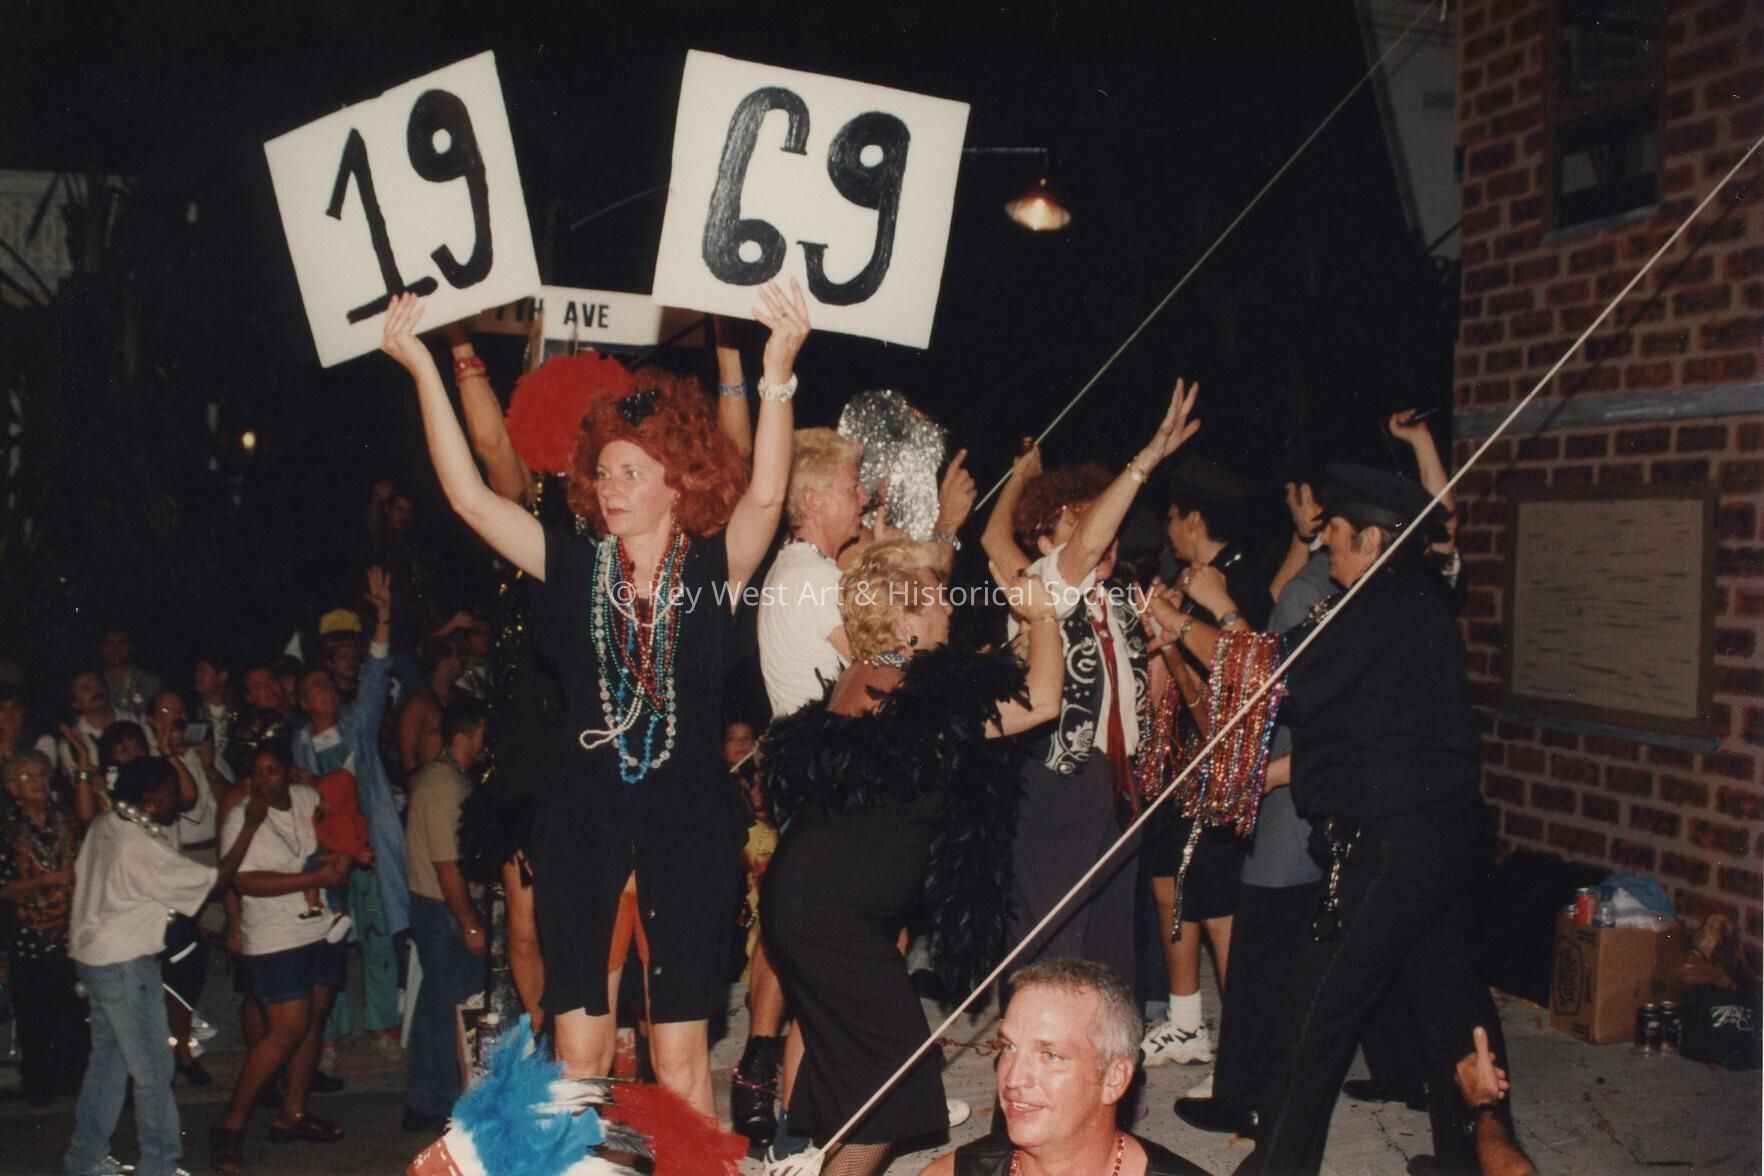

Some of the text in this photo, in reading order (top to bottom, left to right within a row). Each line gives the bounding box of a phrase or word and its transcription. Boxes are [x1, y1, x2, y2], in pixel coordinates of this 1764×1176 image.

[326, 88, 493, 325] 19
[702, 86, 911, 307] 69
[563, 300, 610, 329] AVE
